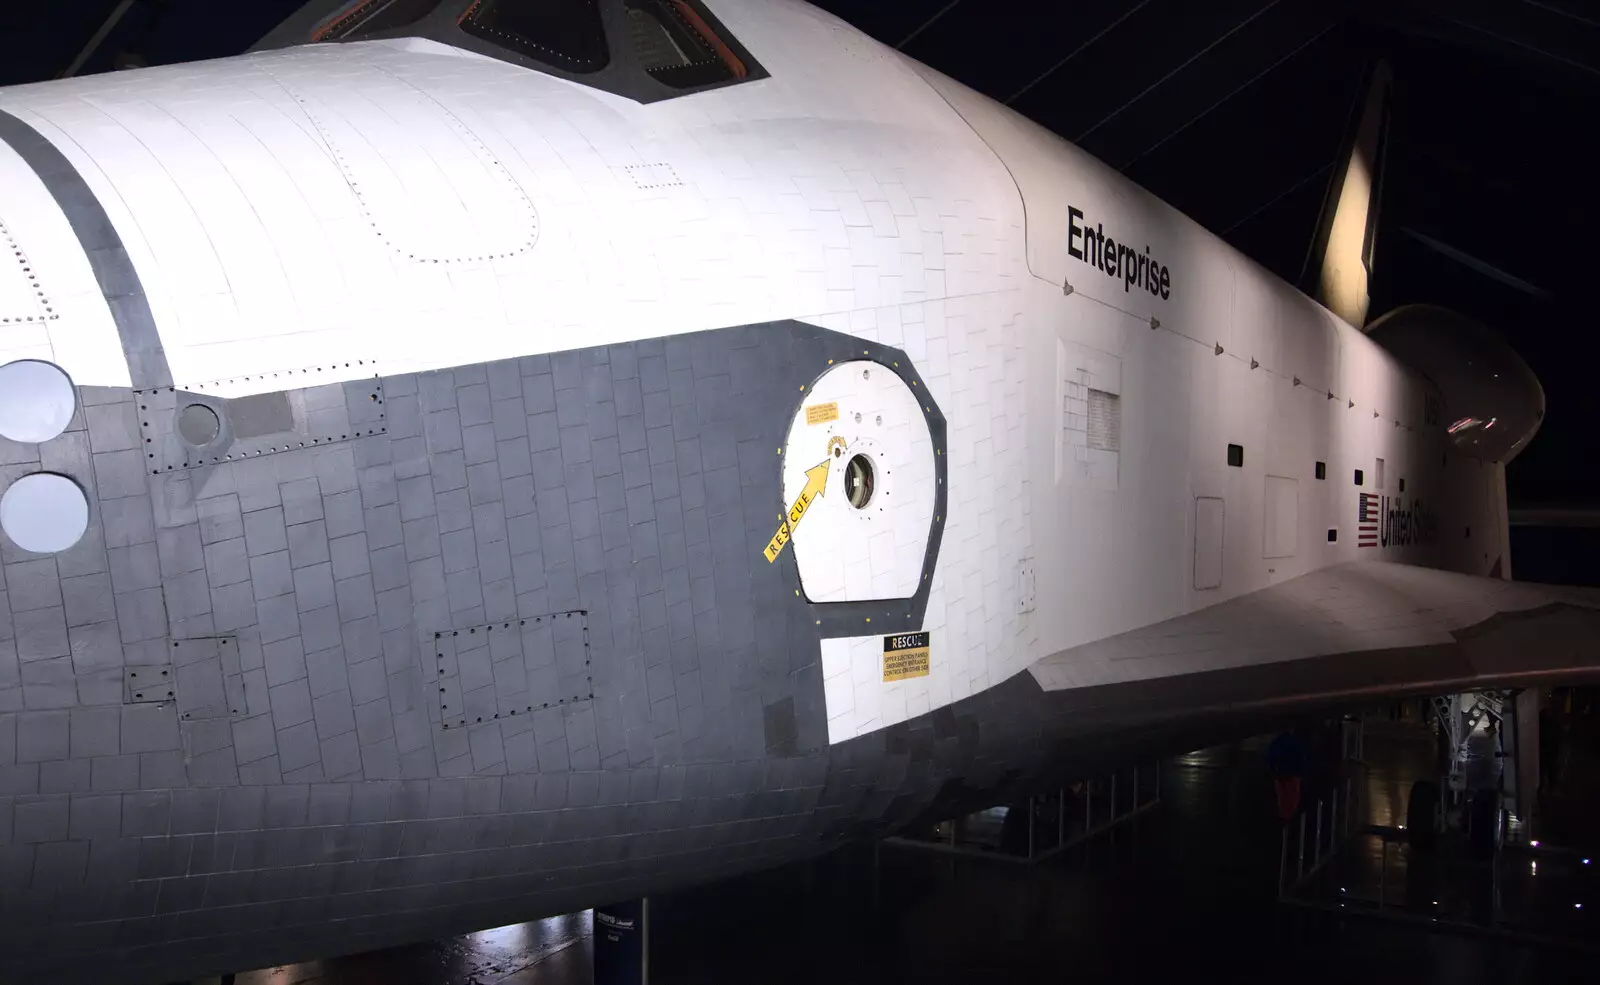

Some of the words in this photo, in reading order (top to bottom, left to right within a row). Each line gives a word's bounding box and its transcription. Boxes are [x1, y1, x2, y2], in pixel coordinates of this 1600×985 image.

[1068, 204, 1170, 301] Enterprise
[769, 493, 810, 555] RESCUE
[1381, 496, 1412, 548] United
[892, 634, 922, 648] RESCUE
[884, 668, 902, 677] CONTROL
